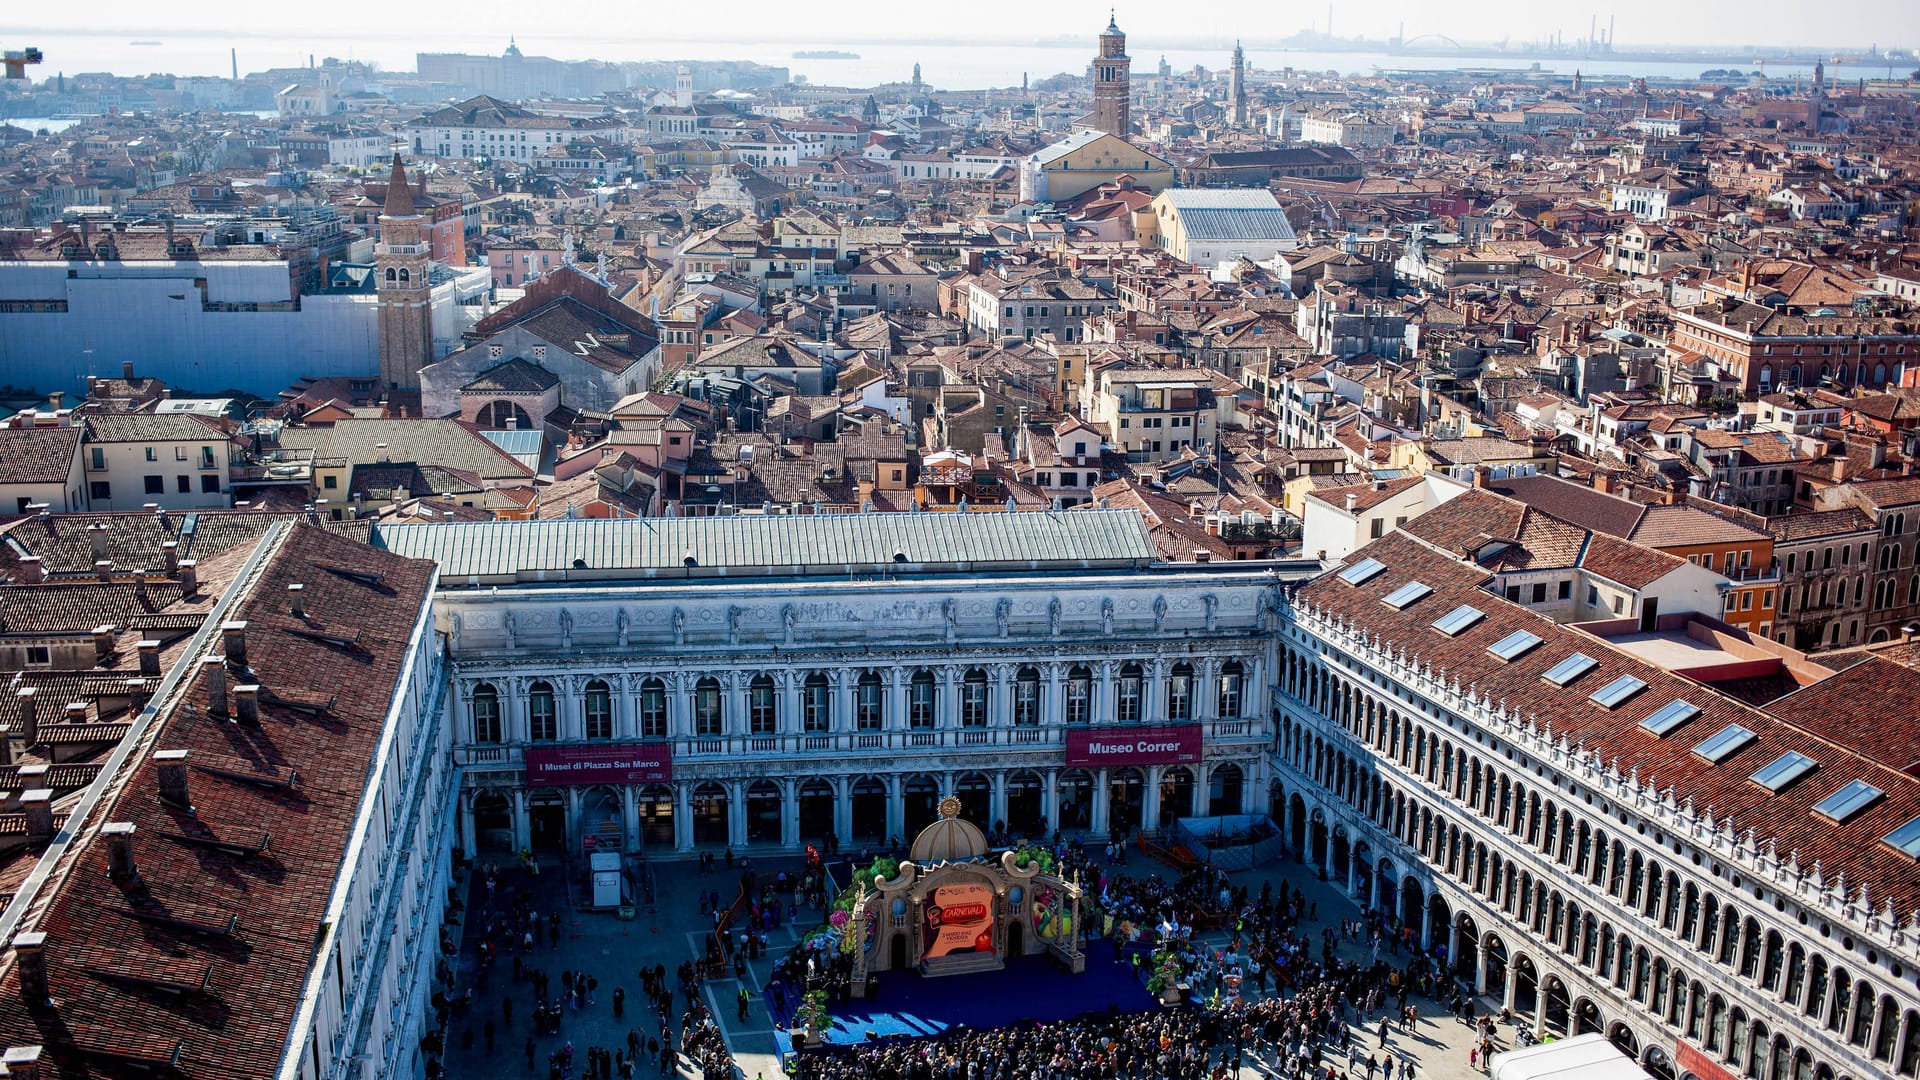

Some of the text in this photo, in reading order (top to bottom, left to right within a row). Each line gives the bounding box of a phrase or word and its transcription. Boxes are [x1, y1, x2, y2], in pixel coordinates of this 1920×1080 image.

[1089, 741, 1181, 754] Museo Correr
[544, 762, 571, 771] Musei
[573, 762, 582, 770] di
[584, 761, 612, 770] Piazza
[614, 761, 630, 769] San
[633, 760, 660, 769] Marco
[943, 906, 984, 918] CARNEVALI
